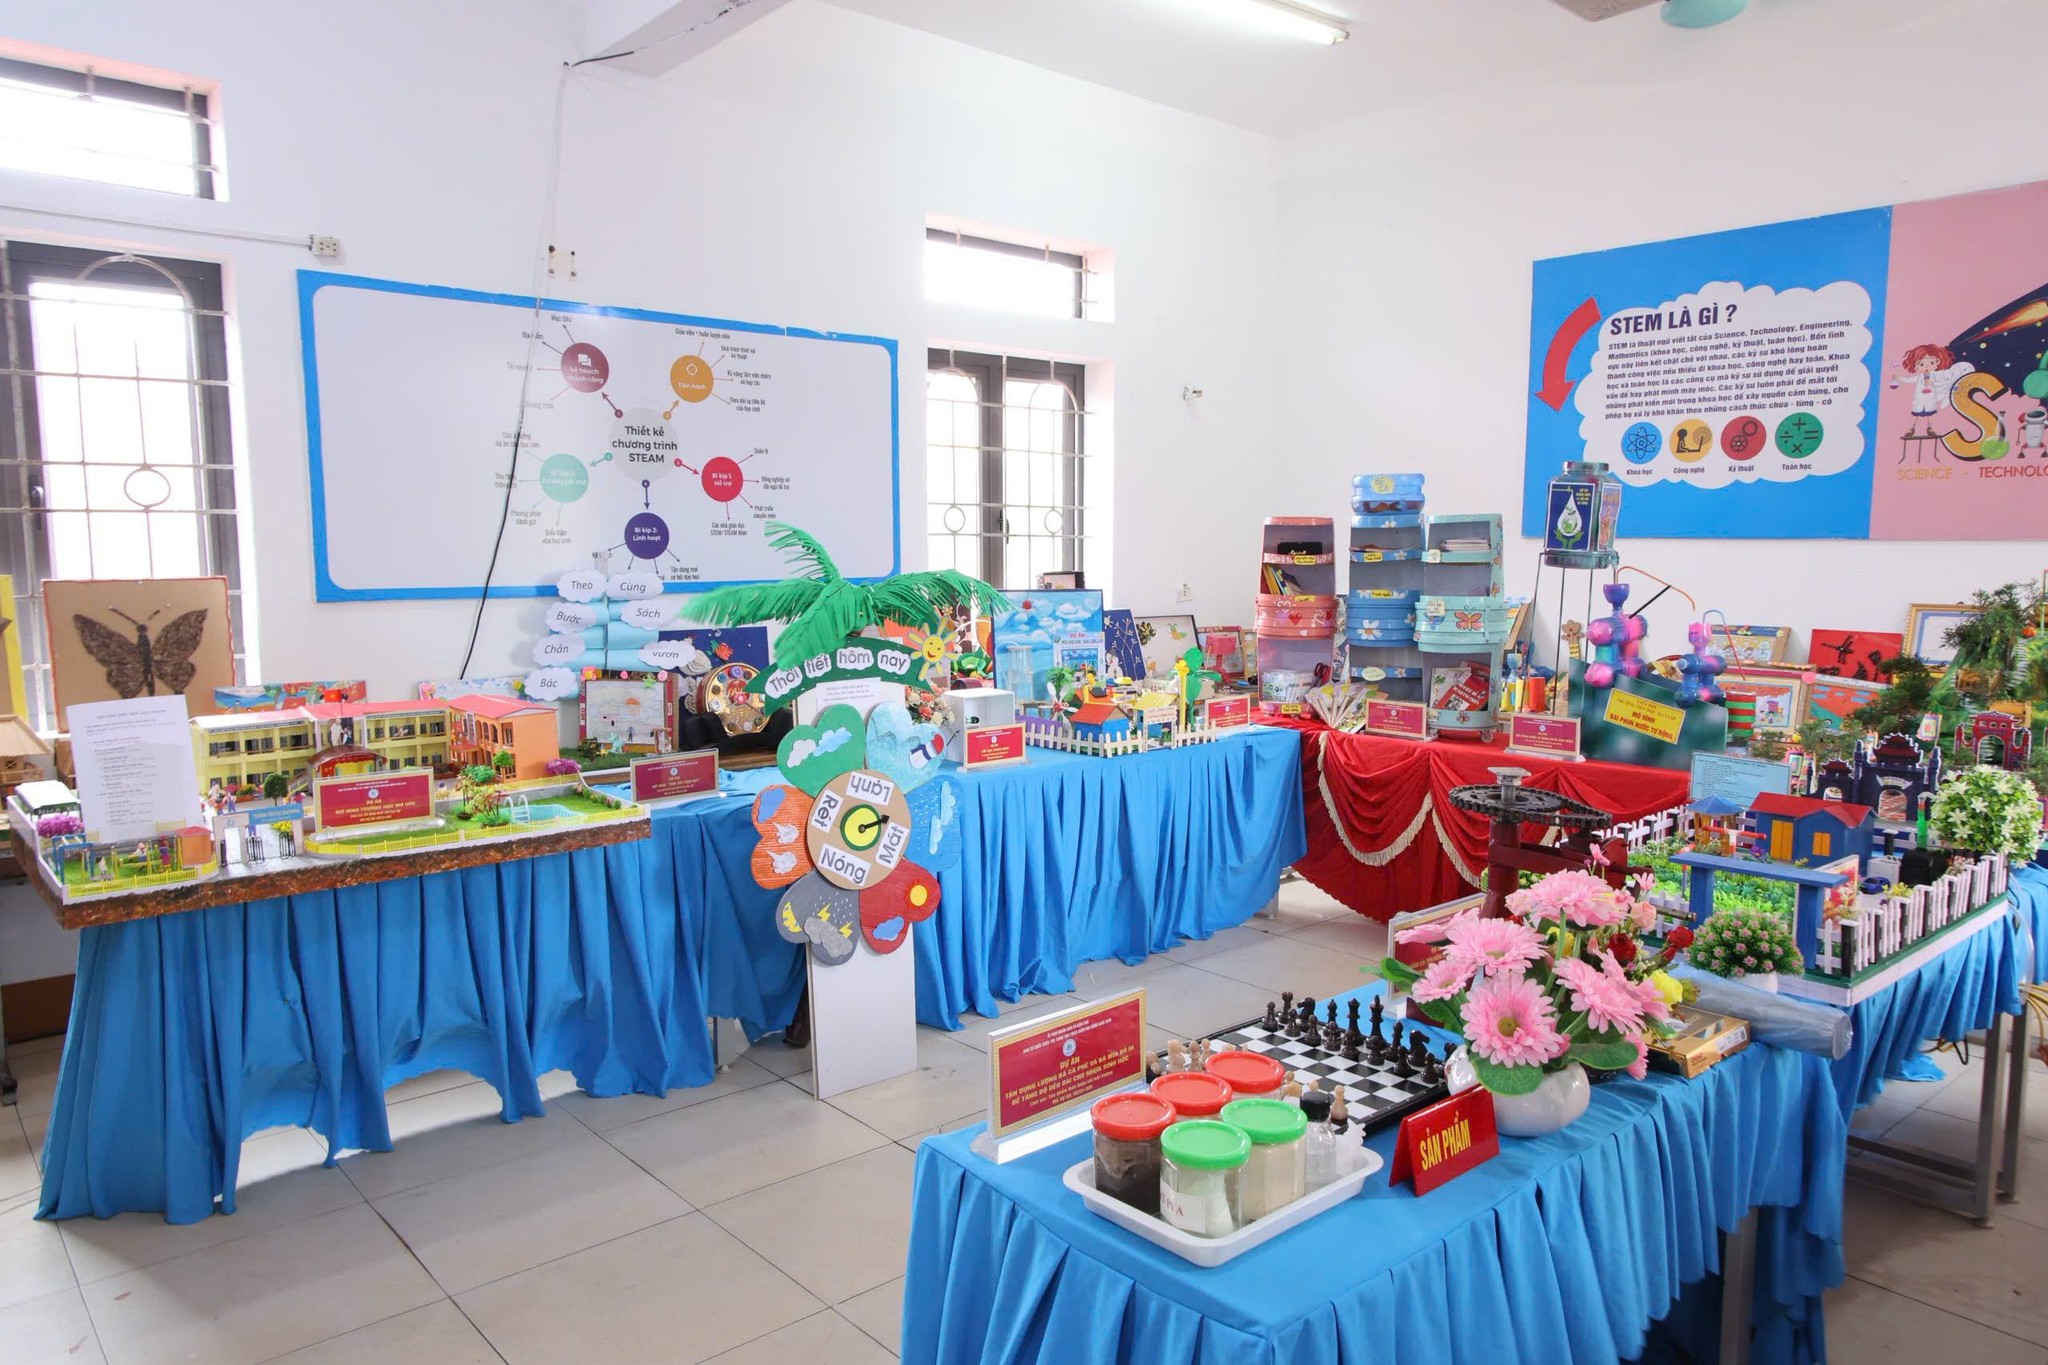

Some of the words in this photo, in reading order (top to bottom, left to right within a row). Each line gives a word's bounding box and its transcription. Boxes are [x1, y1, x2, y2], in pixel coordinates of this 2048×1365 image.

[1610, 313, 1662, 335] STEM
[1668, 306, 1692, 329] LÀ
[1698, 302, 1719, 326] GÌ
[1725, 304, 1738, 323] ?
[1608, 342, 1627, 351] STEM
[1637, 339, 1655, 348] thuật
[1672, 336, 1685, 344] viết
[1650, 349, 1670, 357] (khoa
[1689, 345, 1708, 353] công
[1767, 337, 1785, 345] toán
[1746, 360, 1765, 368] công
[1767, 358, 1787, 367] nghệ
[1789, 357, 1804, 365] hay
[1828, 353, 1850, 361] Khoa
[1685, 376, 1704, 384] công
[624, 425, 650, 437] Thiết
[653, 426, 665, 437] kế
[612, 439, 650, 451] chương
[653, 440, 678, 451] trình
[629, 453, 665, 464] STEAM
[1642, 468, 1653, 476] học
[1673, 466, 1689, 476] Công
[1690, 465, 1705, 475] nghệ
[1737, 464, 1755, 473] thuật
[1782, 462, 1797, 471] Toán
[1798, 462, 1812, 472] học
[1897, 467, 1952, 480] SCIENCE
[571, 580, 593, 590] Theo
[620, 582, 646, 594] Cùng
[556, 611, 583, 624] Bước
[635, 608, 661, 619] Sách
[652, 650, 679, 660] vươn
[769, 669, 800, 693] Thời
[805, 653, 830, 675] tiết
[838, 650, 871, 664] hôm
[880, 653, 907, 671] nay
[539, 678, 558, 688] Bác
[850, 775, 891, 803] Lạnh
[814, 794, 839, 828] Rét
[878, 825, 905, 865] Mát
[821, 848, 867, 885] Nóng
[1060, 1060, 1070, 1070] DỰ
[1070, 1056, 1080, 1066] ÁN
[1072, 1072, 1085, 1082] CHO
[1103, 1060, 1117, 1070] SINH
[1018, 1082, 1037, 1094] DỤNG
[1037, 1076, 1058, 1088] LƯỢNG
[1419, 1127, 1443, 1171] SẢN
[1442, 1110, 1472, 1160] PHẨM
